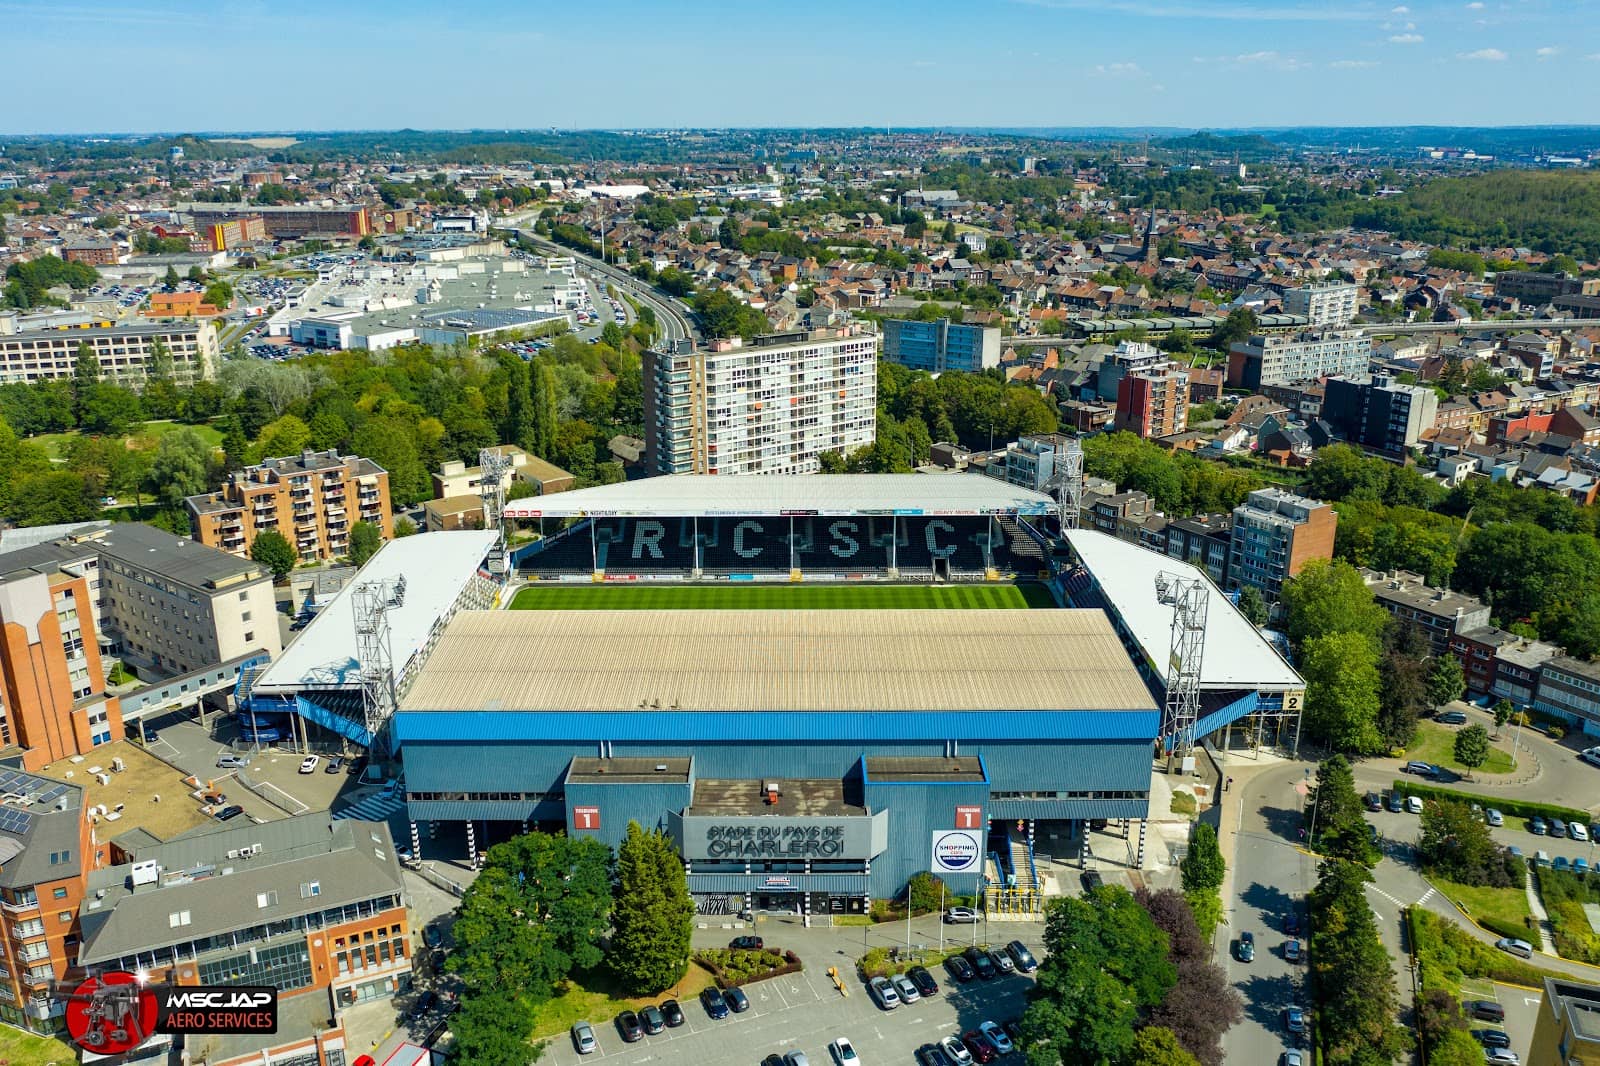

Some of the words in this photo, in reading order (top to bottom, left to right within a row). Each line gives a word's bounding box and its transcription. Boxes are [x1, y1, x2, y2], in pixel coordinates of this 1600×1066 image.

[1288, 697, 1297, 708] 2
[583, 813, 591, 828] 1
[964, 813, 972, 828] 1
[708, 825, 757, 837] STADE
[760, 825, 781, 837] DU
[784, 825, 821, 837] PAYS
[824, 825, 845, 837] DE
[710, 839, 845, 855] CHARLEROI
